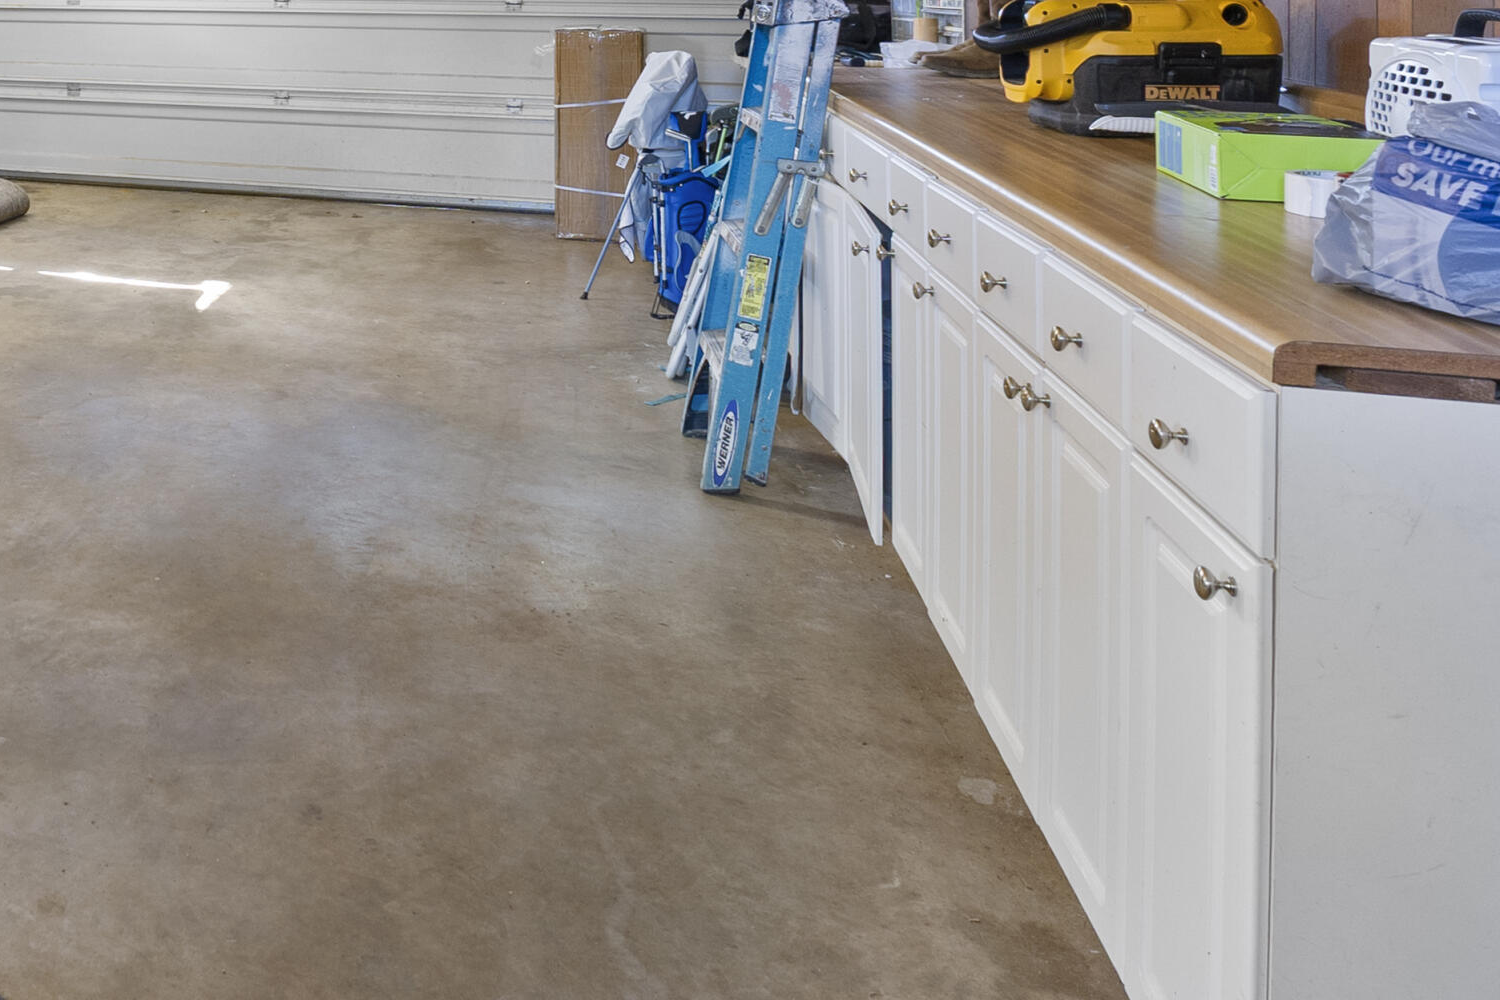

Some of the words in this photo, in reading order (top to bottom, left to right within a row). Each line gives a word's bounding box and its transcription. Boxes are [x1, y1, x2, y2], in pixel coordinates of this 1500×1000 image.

[1407, 140, 1467, 167] Our
[1391, 161, 1489, 211] SAVE
[716, 416, 734, 470] WERNER
